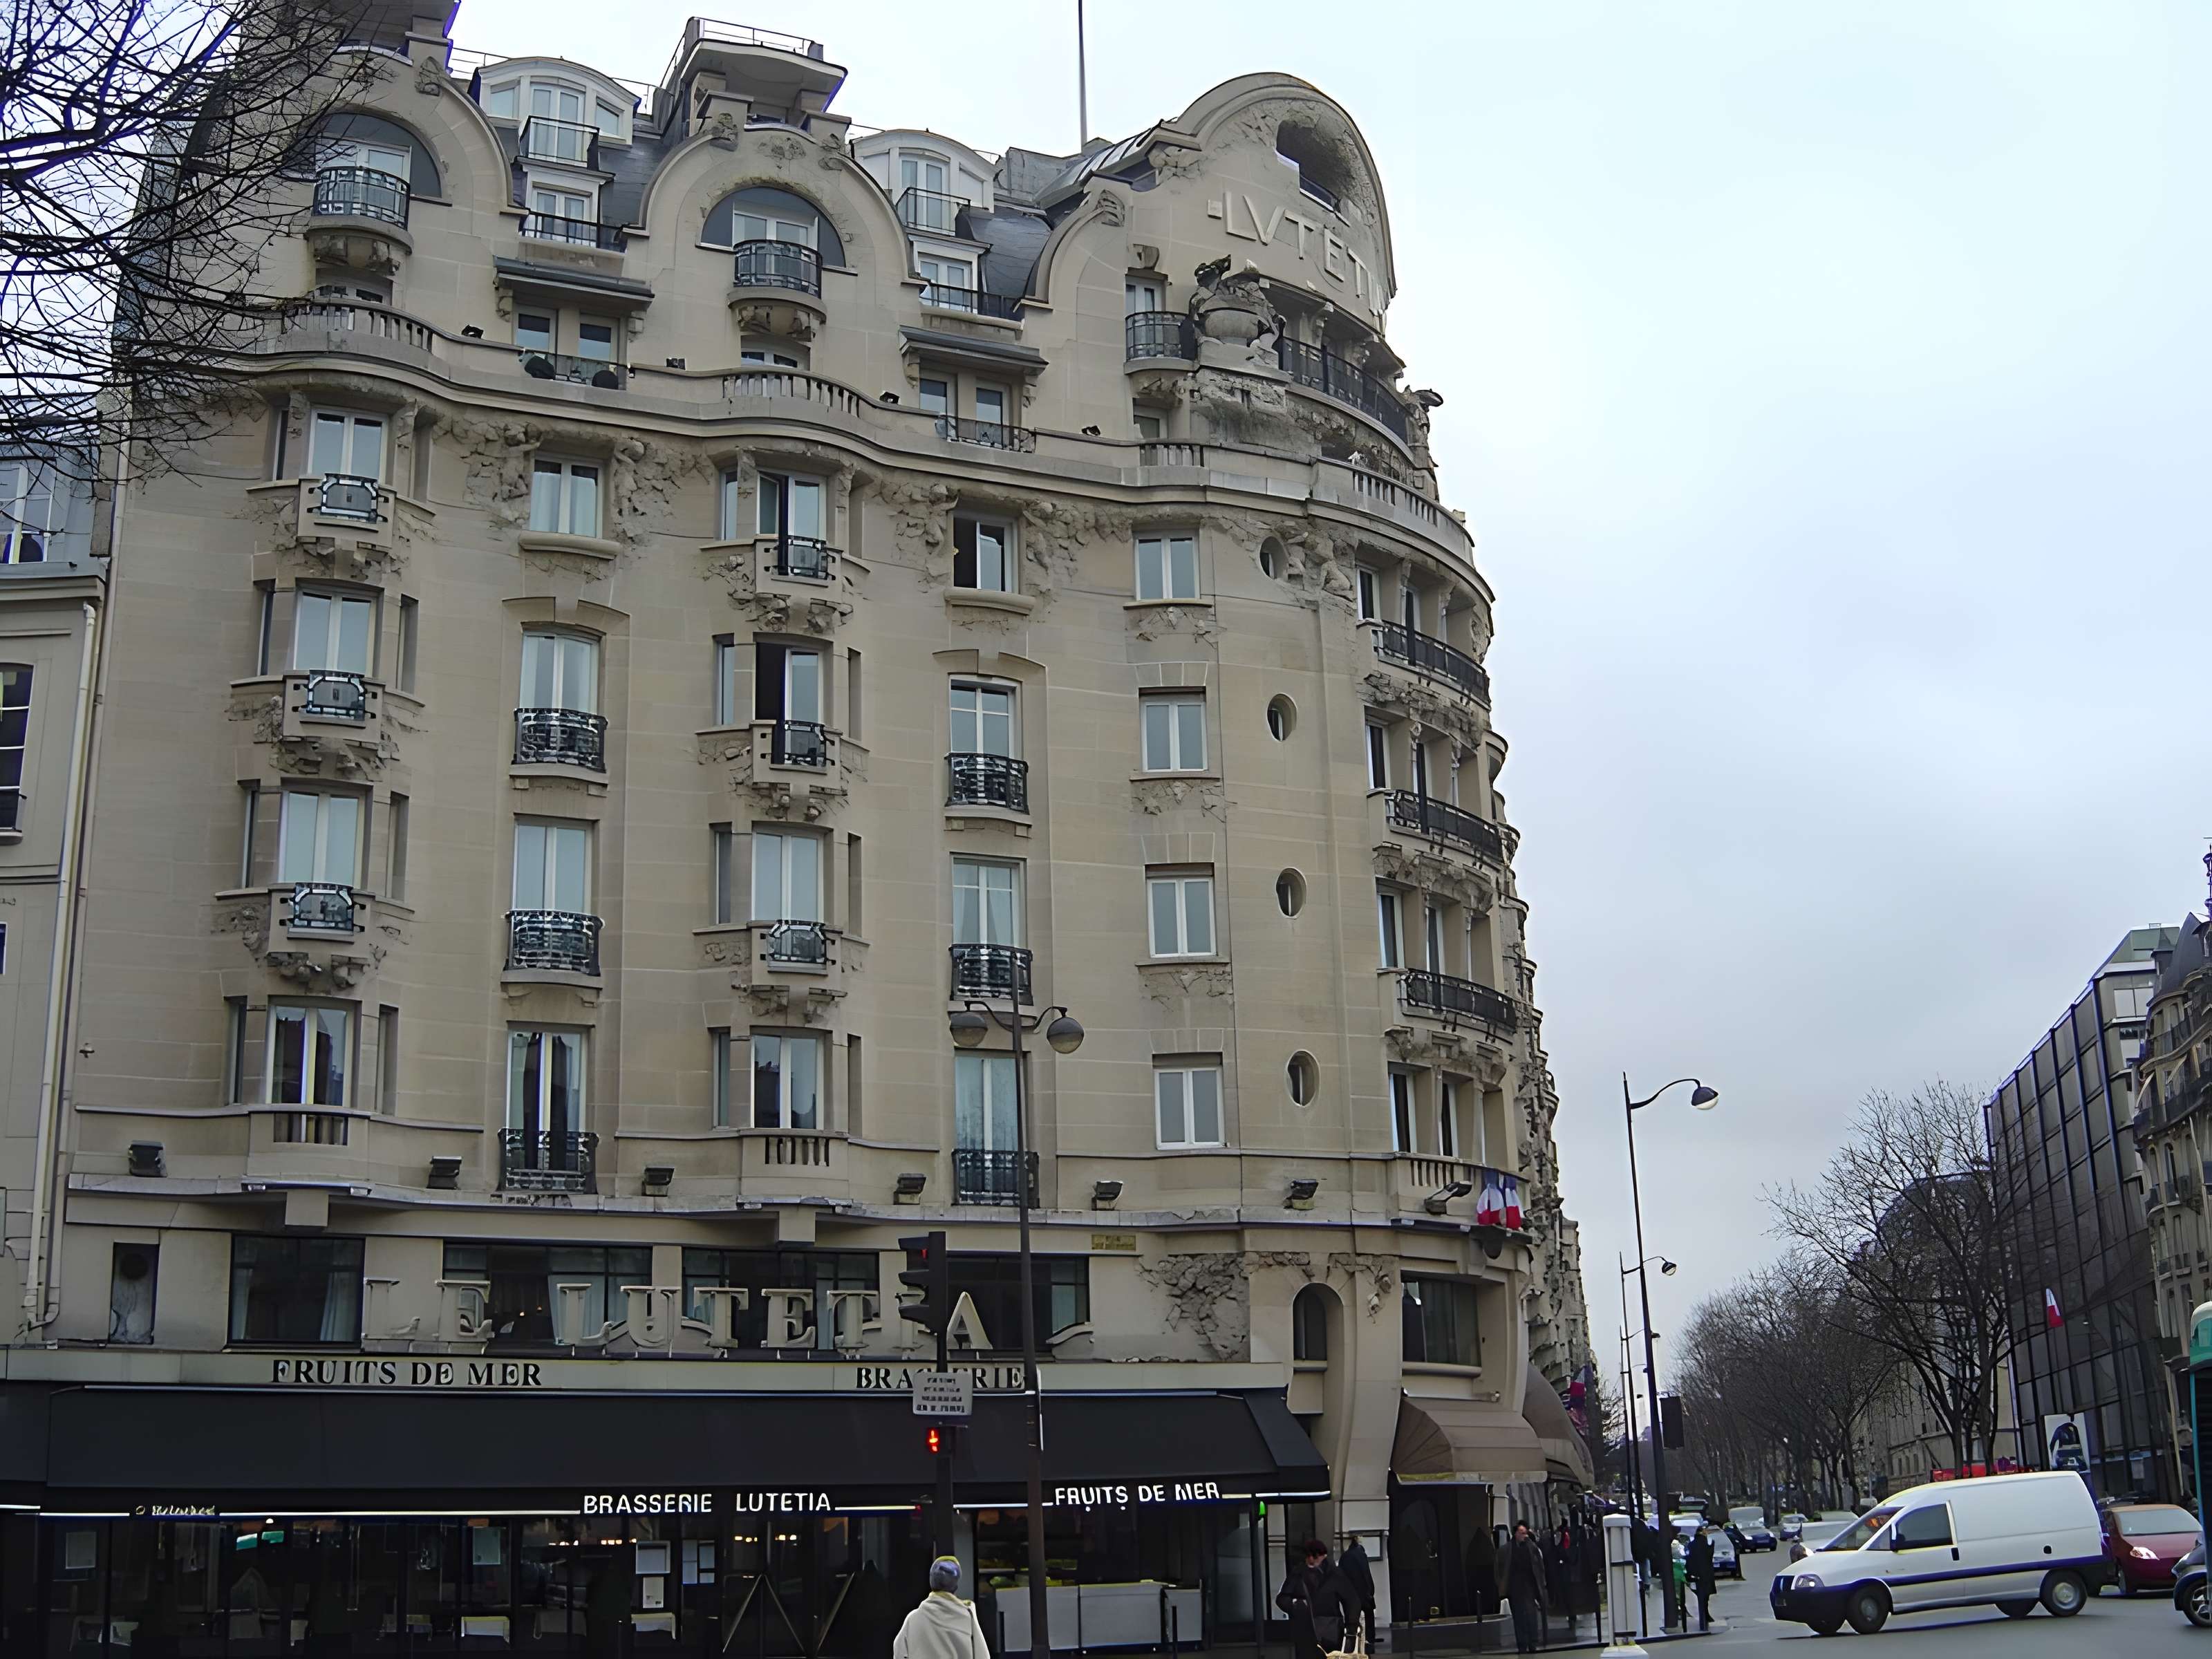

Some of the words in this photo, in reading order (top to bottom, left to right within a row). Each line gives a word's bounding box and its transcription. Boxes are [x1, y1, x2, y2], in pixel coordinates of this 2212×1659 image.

[361, 1277, 495, 1341] LE
[272, 1359, 397, 1386] FRUITS
[410, 1362, 454, 1386] DE
[467, 1362, 542, 1387] MER
[856, 1367, 1026, 1389] BRARIE
[583, 1492, 713, 1515] BRASSERIE
[735, 1492, 832, 1512] LUTETIA
[1054, 1485, 1129, 1506] FRUITS
[1138, 1484, 1167, 1503] DE
[1174, 1481, 1221, 1501] MER
